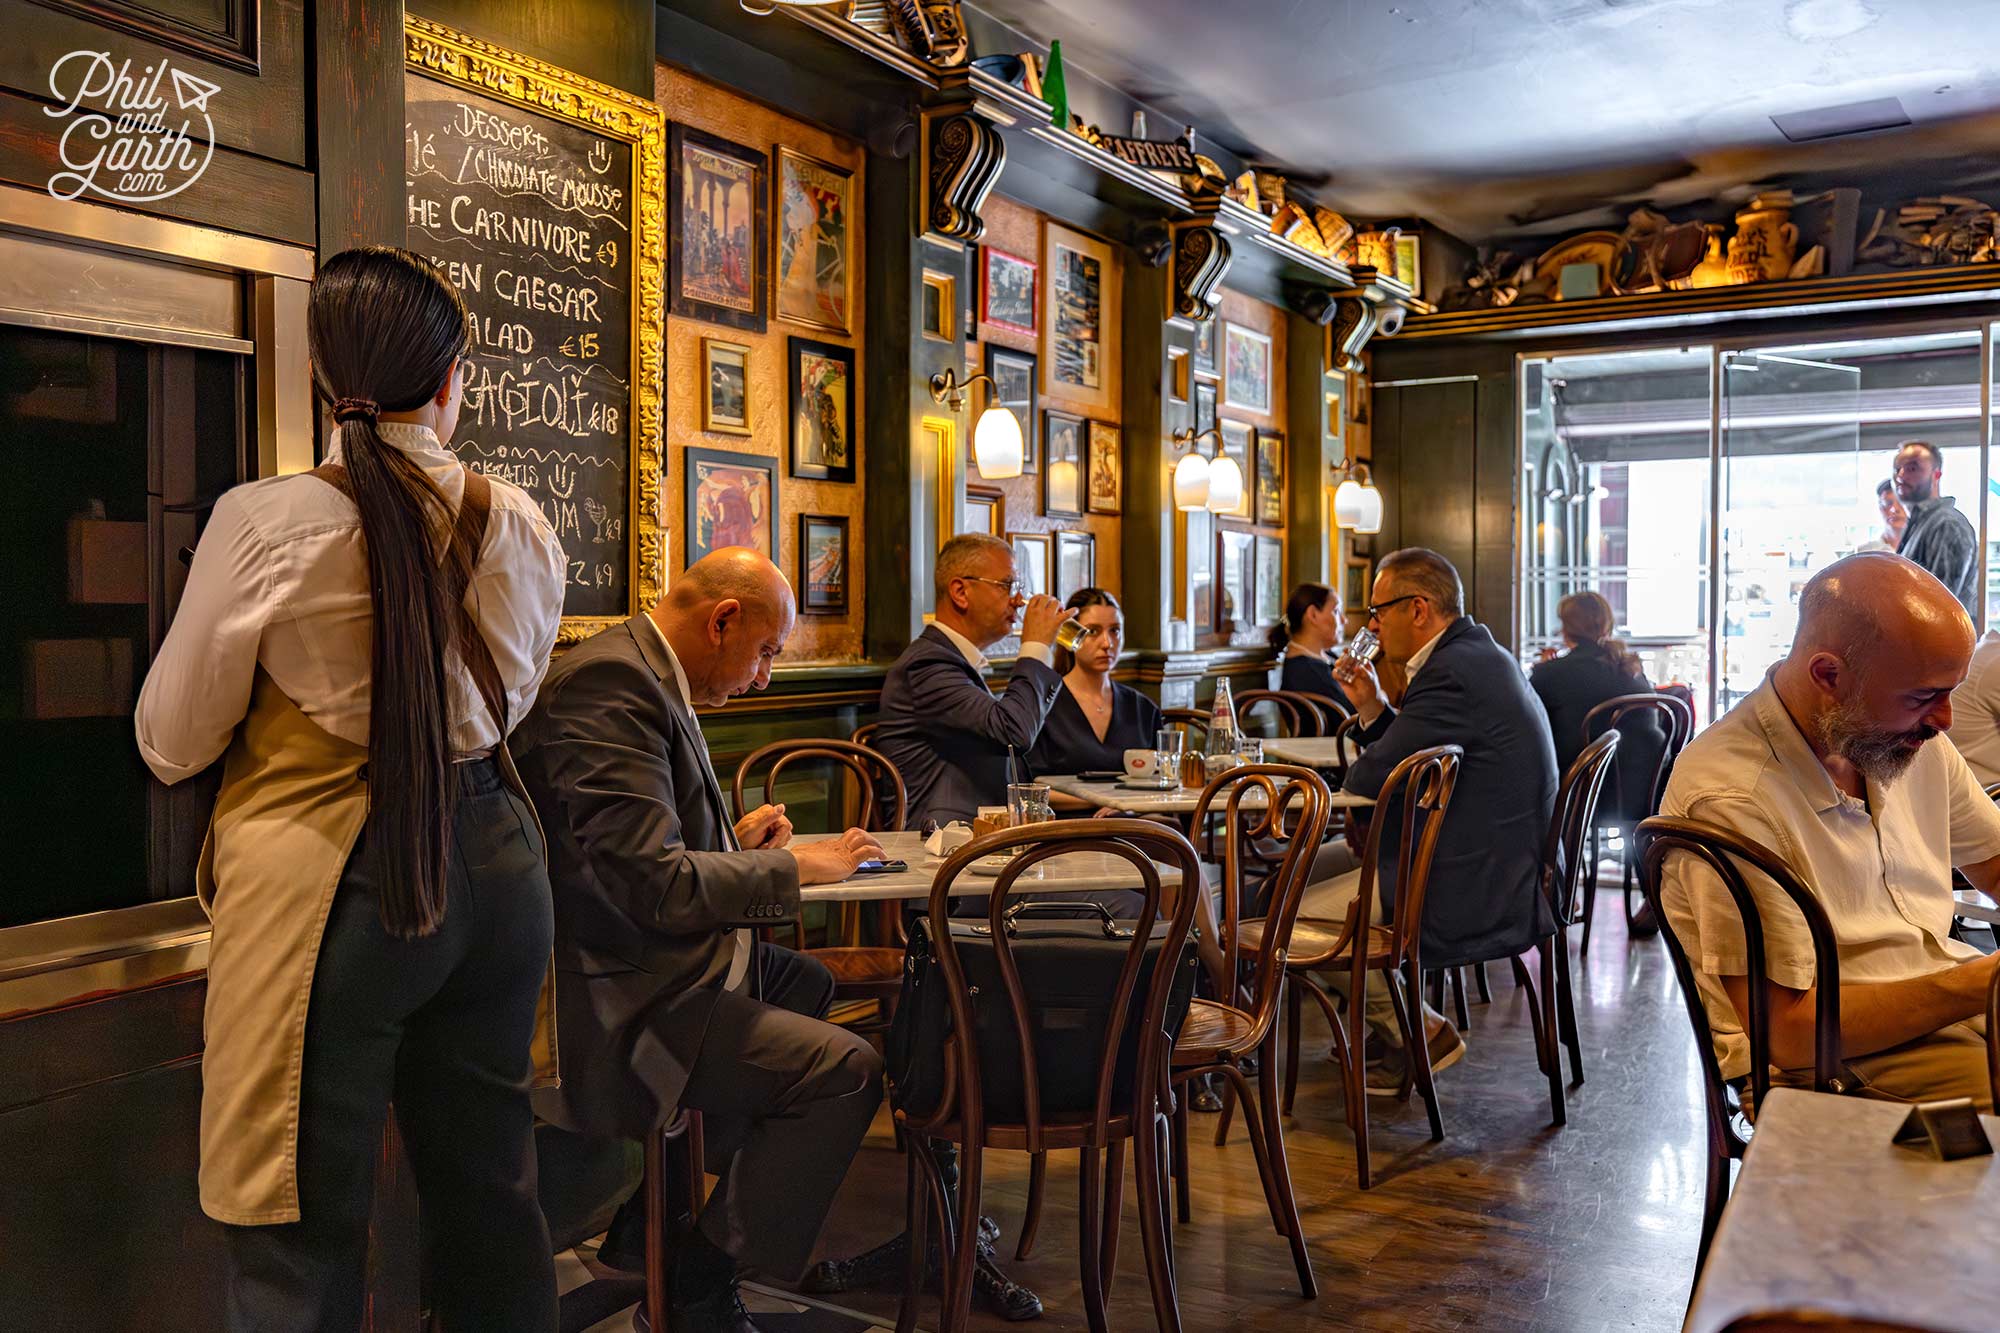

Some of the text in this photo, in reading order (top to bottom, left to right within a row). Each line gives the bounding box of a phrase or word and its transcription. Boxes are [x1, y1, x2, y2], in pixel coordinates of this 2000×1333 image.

[406, 122, 436, 171] lé
[406, 181, 618, 268] HE CARNIVORE €9
[494, 269, 602, 323] CAESAR
[468, 311, 599, 359] ALAD €15
